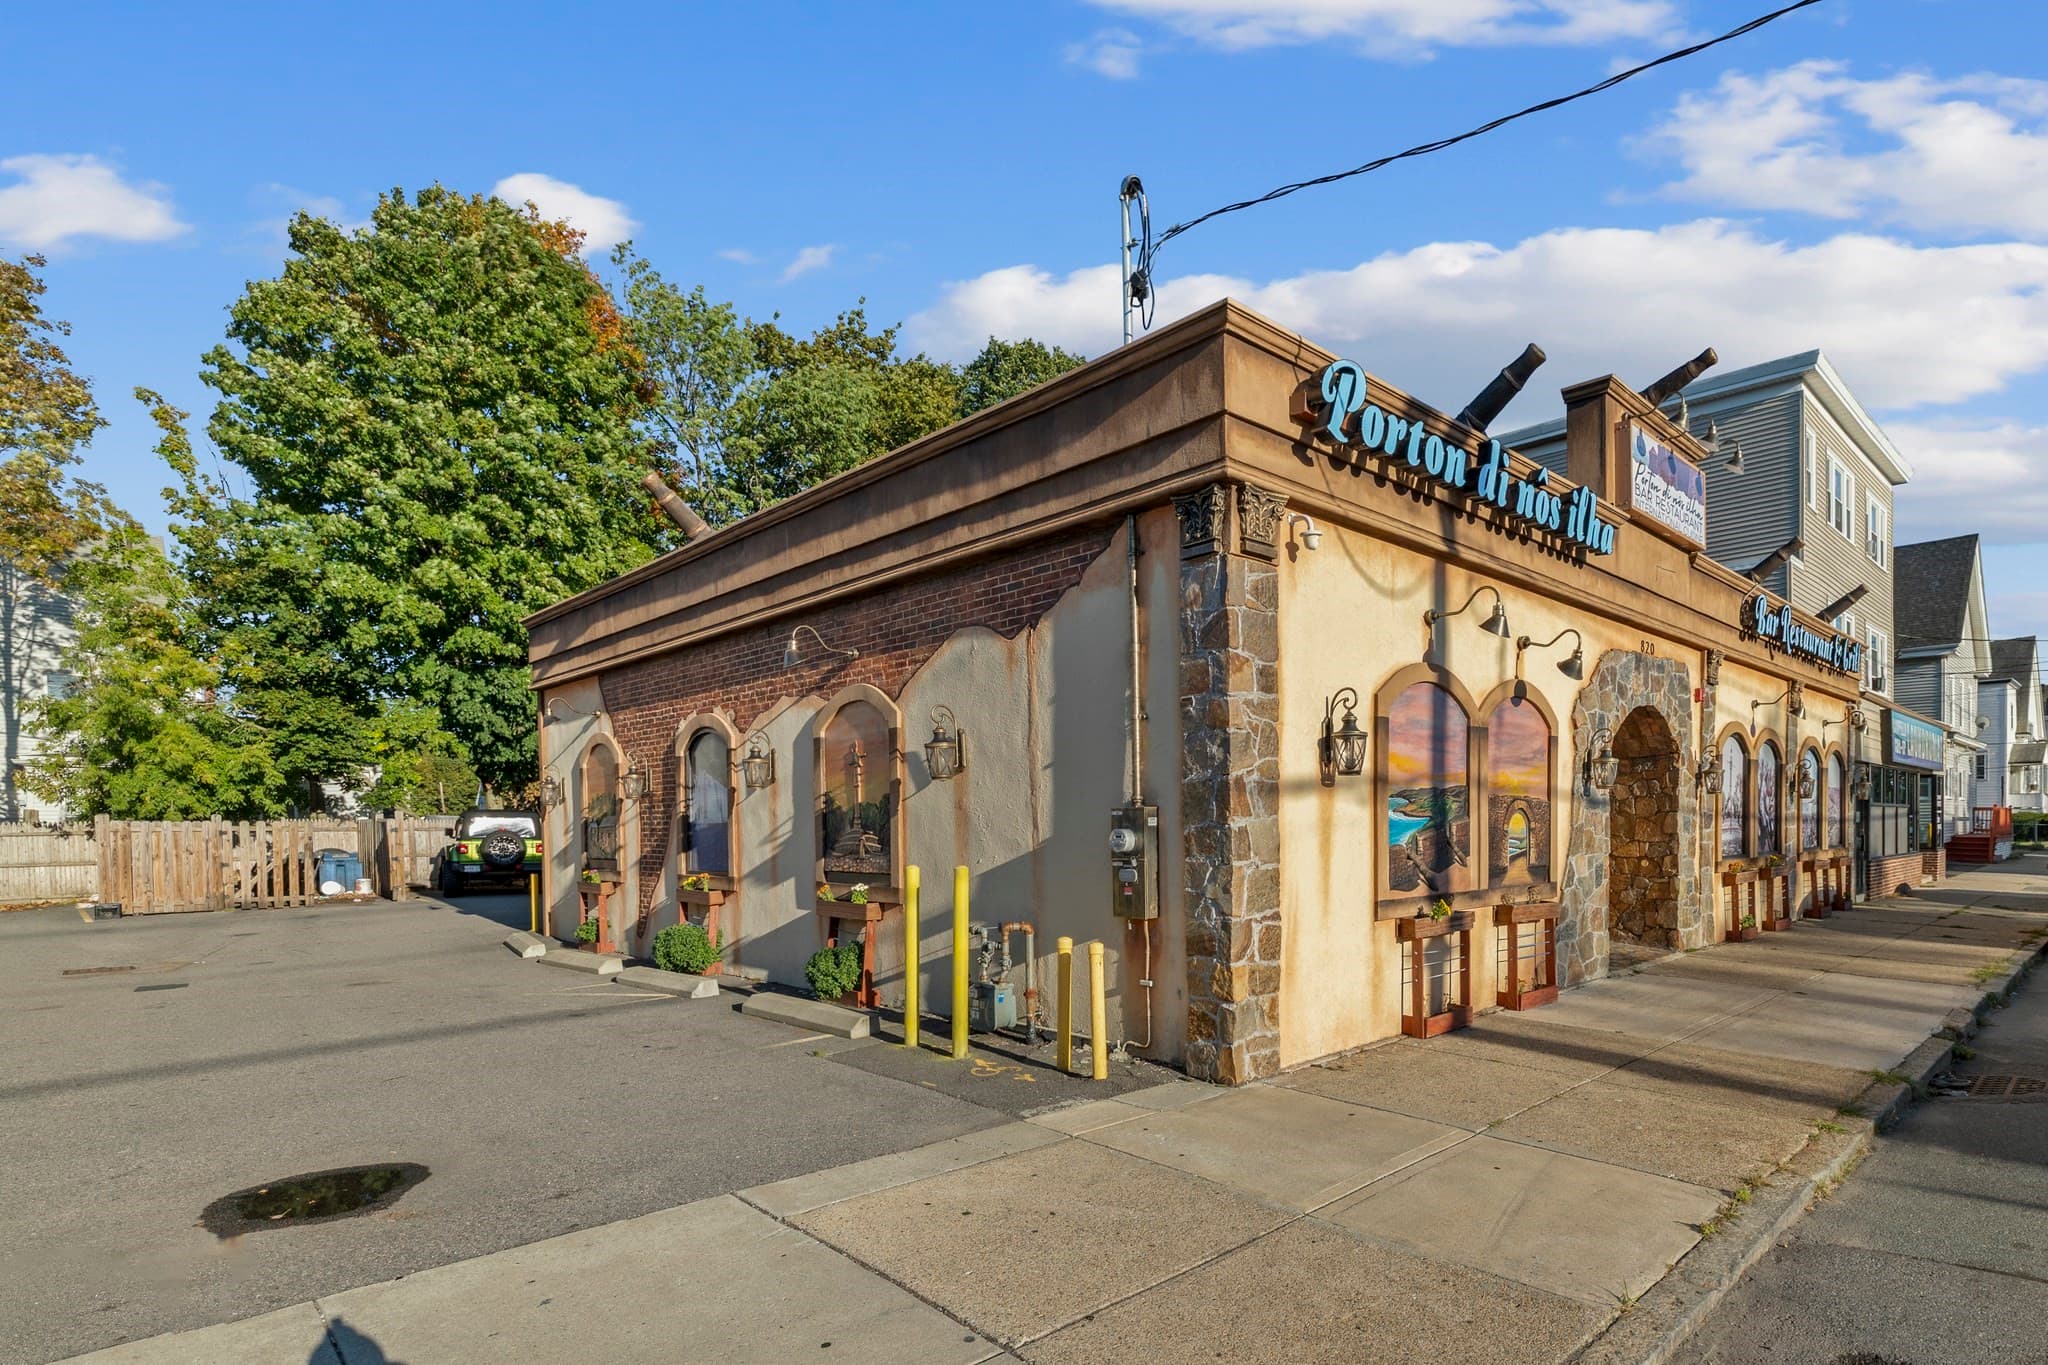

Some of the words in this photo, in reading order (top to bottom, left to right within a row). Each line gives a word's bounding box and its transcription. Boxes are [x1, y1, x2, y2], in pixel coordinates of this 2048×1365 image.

[1321, 359, 1467, 487] Porton
[1478, 439, 1511, 507] di
[1516, 467, 1562, 530] nôs
[1568, 486, 1615, 555] ilha
[1635, 483, 1653, 501] BAR
[1656, 495, 1703, 532] RESTAURANT
[1641, 640, 1655, 656] 820
[1756, 594, 1779, 636] Bar
[1781, 605, 1833, 660] Restaurant
[1834, 636, 1842, 667] &
[1843, 640, 1862, 672] Grill
